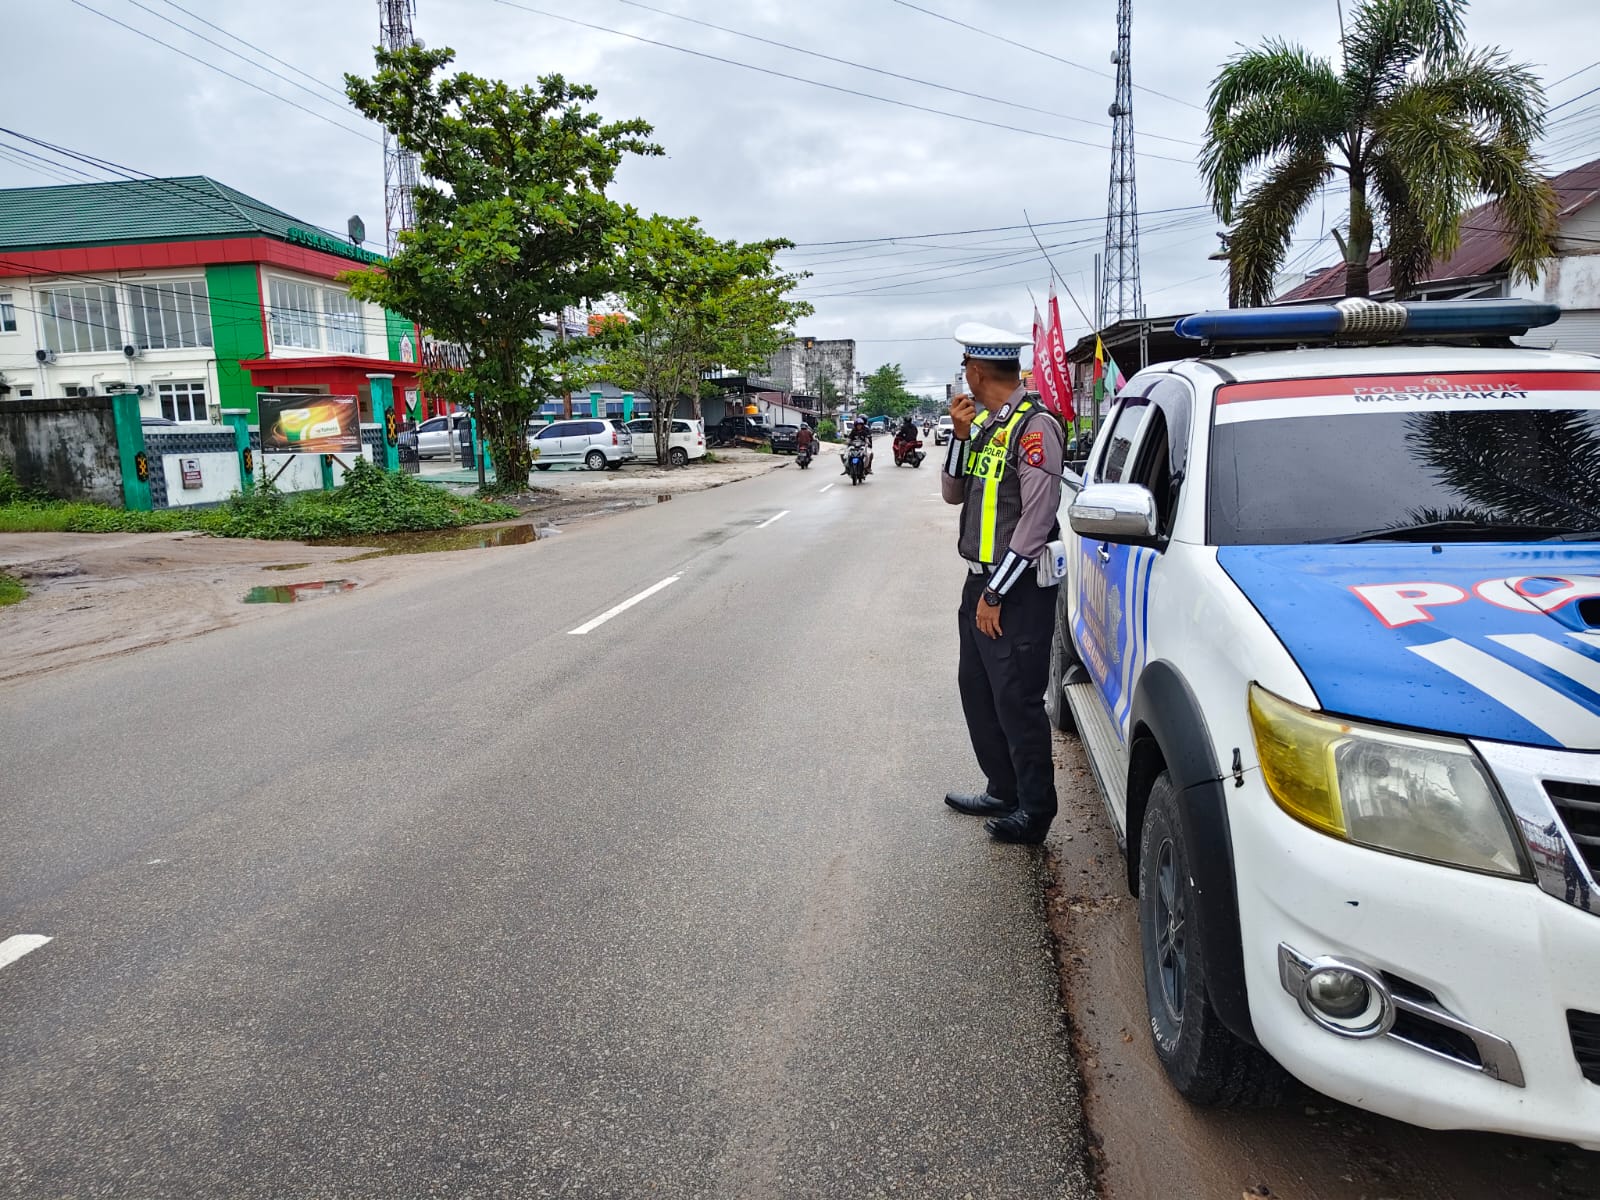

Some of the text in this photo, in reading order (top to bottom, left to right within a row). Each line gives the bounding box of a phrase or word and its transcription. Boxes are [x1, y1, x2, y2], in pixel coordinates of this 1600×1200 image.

[1353, 383, 1522, 395] POLRI UNTUK
[1353, 391, 1529, 403] MASYARAKAT
[984, 446, 1005, 459] POLRI
